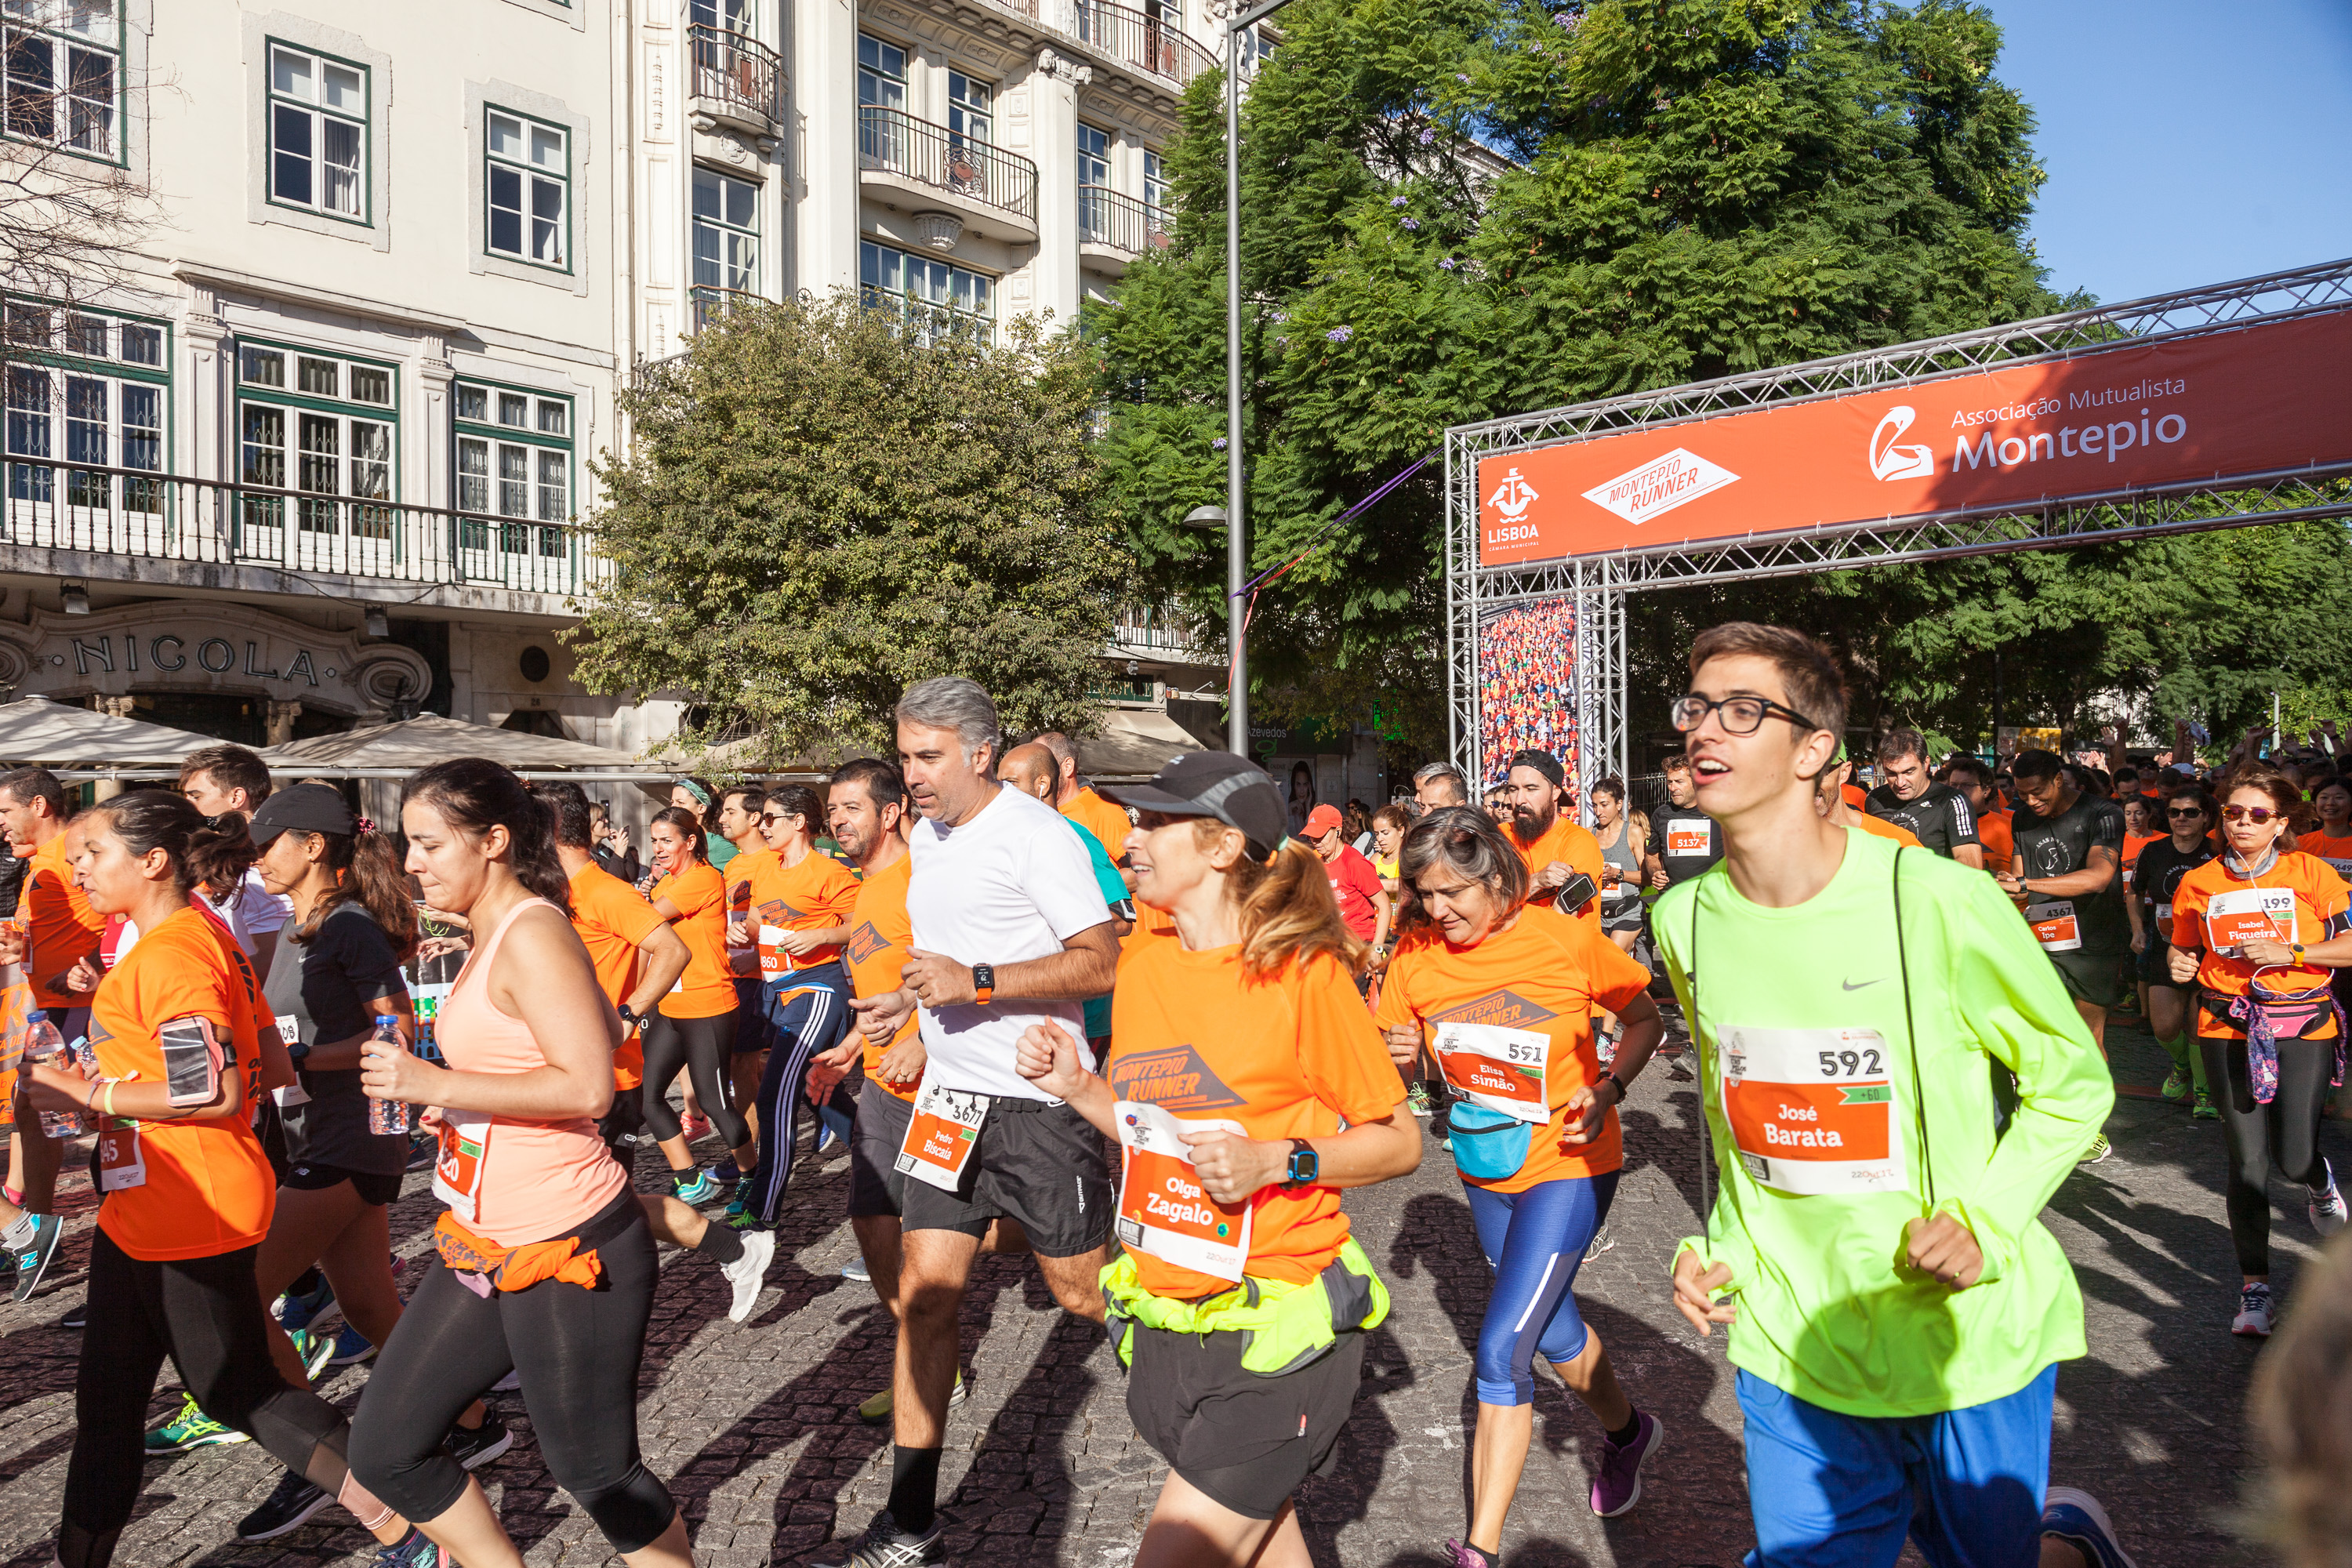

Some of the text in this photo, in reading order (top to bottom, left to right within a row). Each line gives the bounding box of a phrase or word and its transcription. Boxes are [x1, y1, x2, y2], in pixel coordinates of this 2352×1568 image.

[1951, 377, 2186, 429] Associação Mutualista
[1952, 407, 2187, 473] Montepio
[1609, 459, 1681, 505] MONTEPIO
[1630, 467, 1698, 513] RUNNER
[1488, 524, 1539, 543] LISBOA
[71, 634, 319, 687] NICOLA
[1247, 725, 1287, 739] Azevedos
[2021, 735, 2040, 749] SUB
[1677, 838, 1700, 848] 5137
[2166, 866, 2180, 877] ASAS
[2046, 906, 2071, 918] 4367
[2263, 897, 2291, 909] 199
[2238, 920, 2265, 929] Isabel
[1465, 1004, 1522, 1025] UNNER
[1508, 1043, 1542, 1062] 591
[1113, 1055, 1189, 1084] MONTEPIO
[1479, 1064, 1504, 1077] Elisa
[1819, 1049, 1884, 1076] 592
[1127, 1072, 1202, 1102] RUNNER
[1471, 1074, 1515, 1092] Simão
[1860, 1089, 1880, 1101] +60
[953, 1105, 983, 1124] 3677
[1778, 1104, 1817, 1121] José
[935, 1131, 953, 1145] Pedro
[1763, 1123, 1843, 1147] Barata
[924, 1140, 953, 1160] Biscaia
[1166, 1177, 1201, 1199] Olga
[1146, 1192, 1214, 1226] Zagalo
